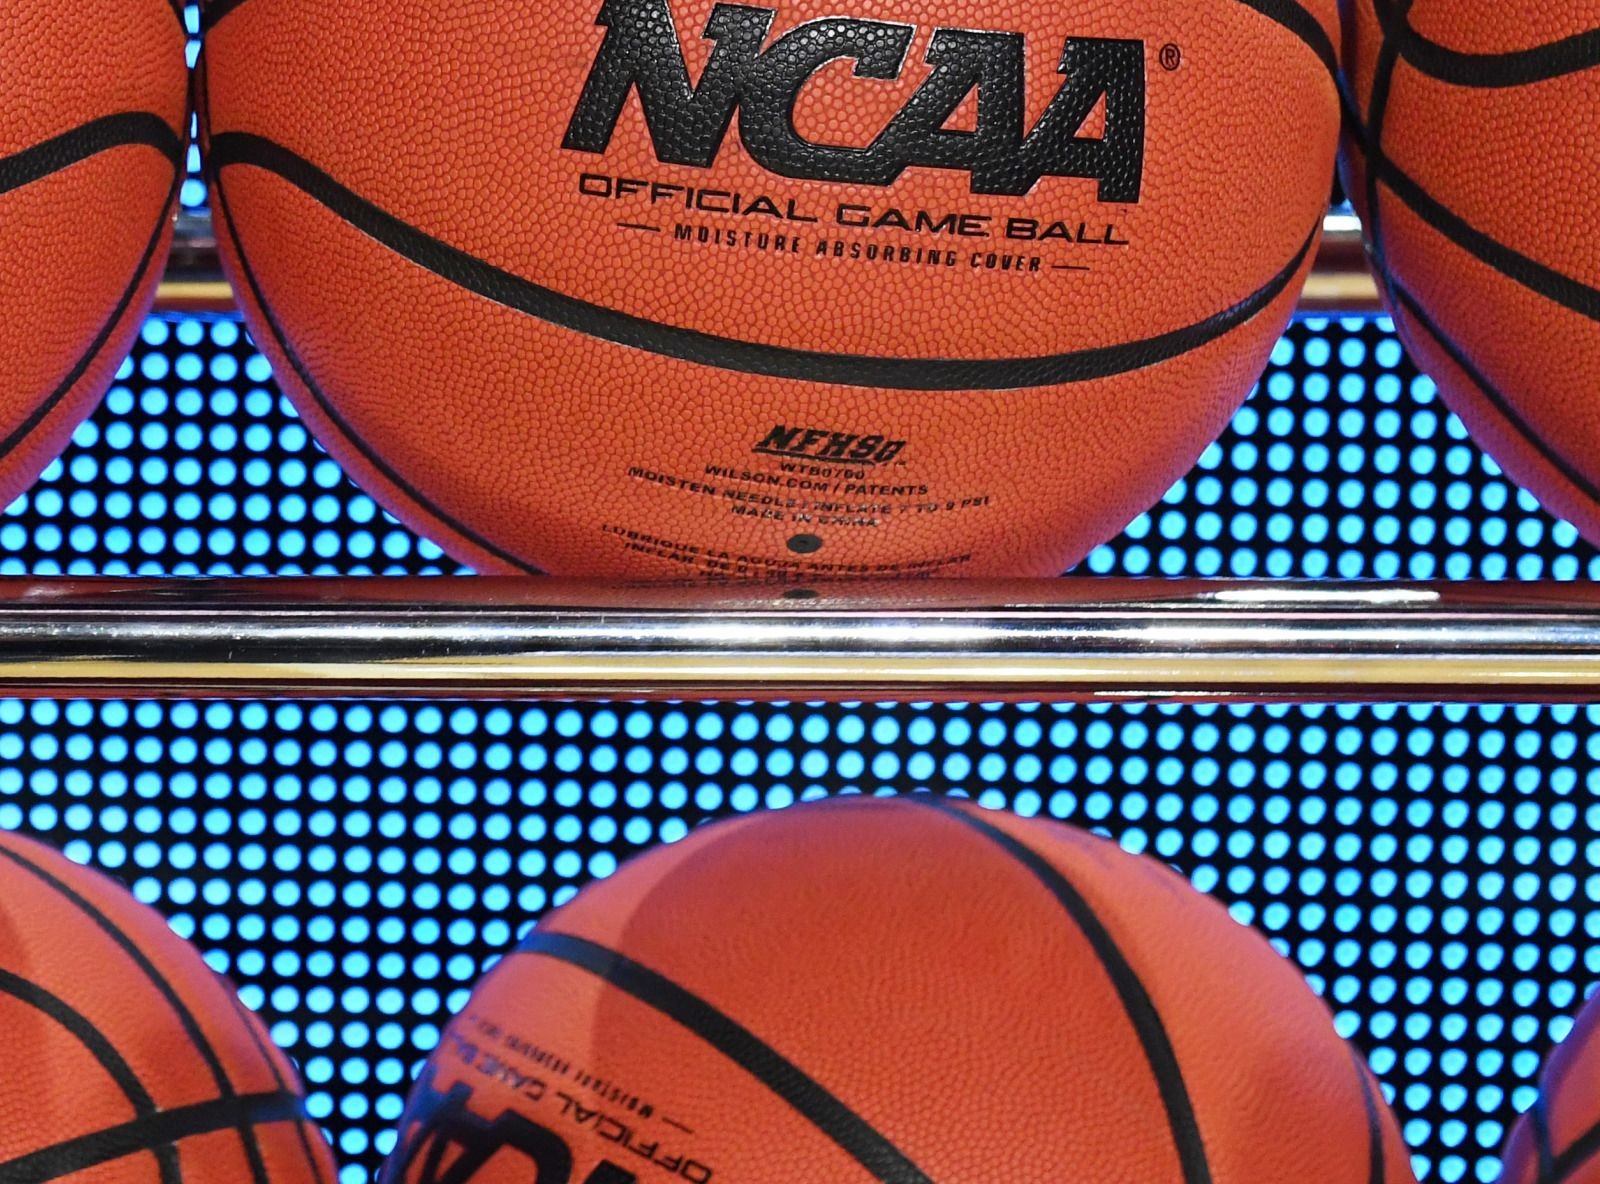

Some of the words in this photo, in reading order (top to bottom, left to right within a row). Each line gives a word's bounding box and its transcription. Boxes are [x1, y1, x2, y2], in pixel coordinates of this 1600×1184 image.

[578, 172, 819, 223] OFFICIAL
[835, 204, 993, 239] GAME
[1004, 217, 1130, 247] BALL
[673, 222, 801, 256] MOISTURE
[814, 239, 957, 269] ABSORBING
[969, 250, 1043, 273] COVER
[627, 466, 716, 496] MOISTEN
[722, 489, 797, 509] NEEDLE
[961, 495, 990, 508] PSI
[705, 464, 828, 494] WILSON.COM
[844, 484, 929, 496] PATENTS
[731, 504, 785, 521] MADE
[792, 513, 812, 524] IN
[601, 523, 700, 553] LUBRIQUE
